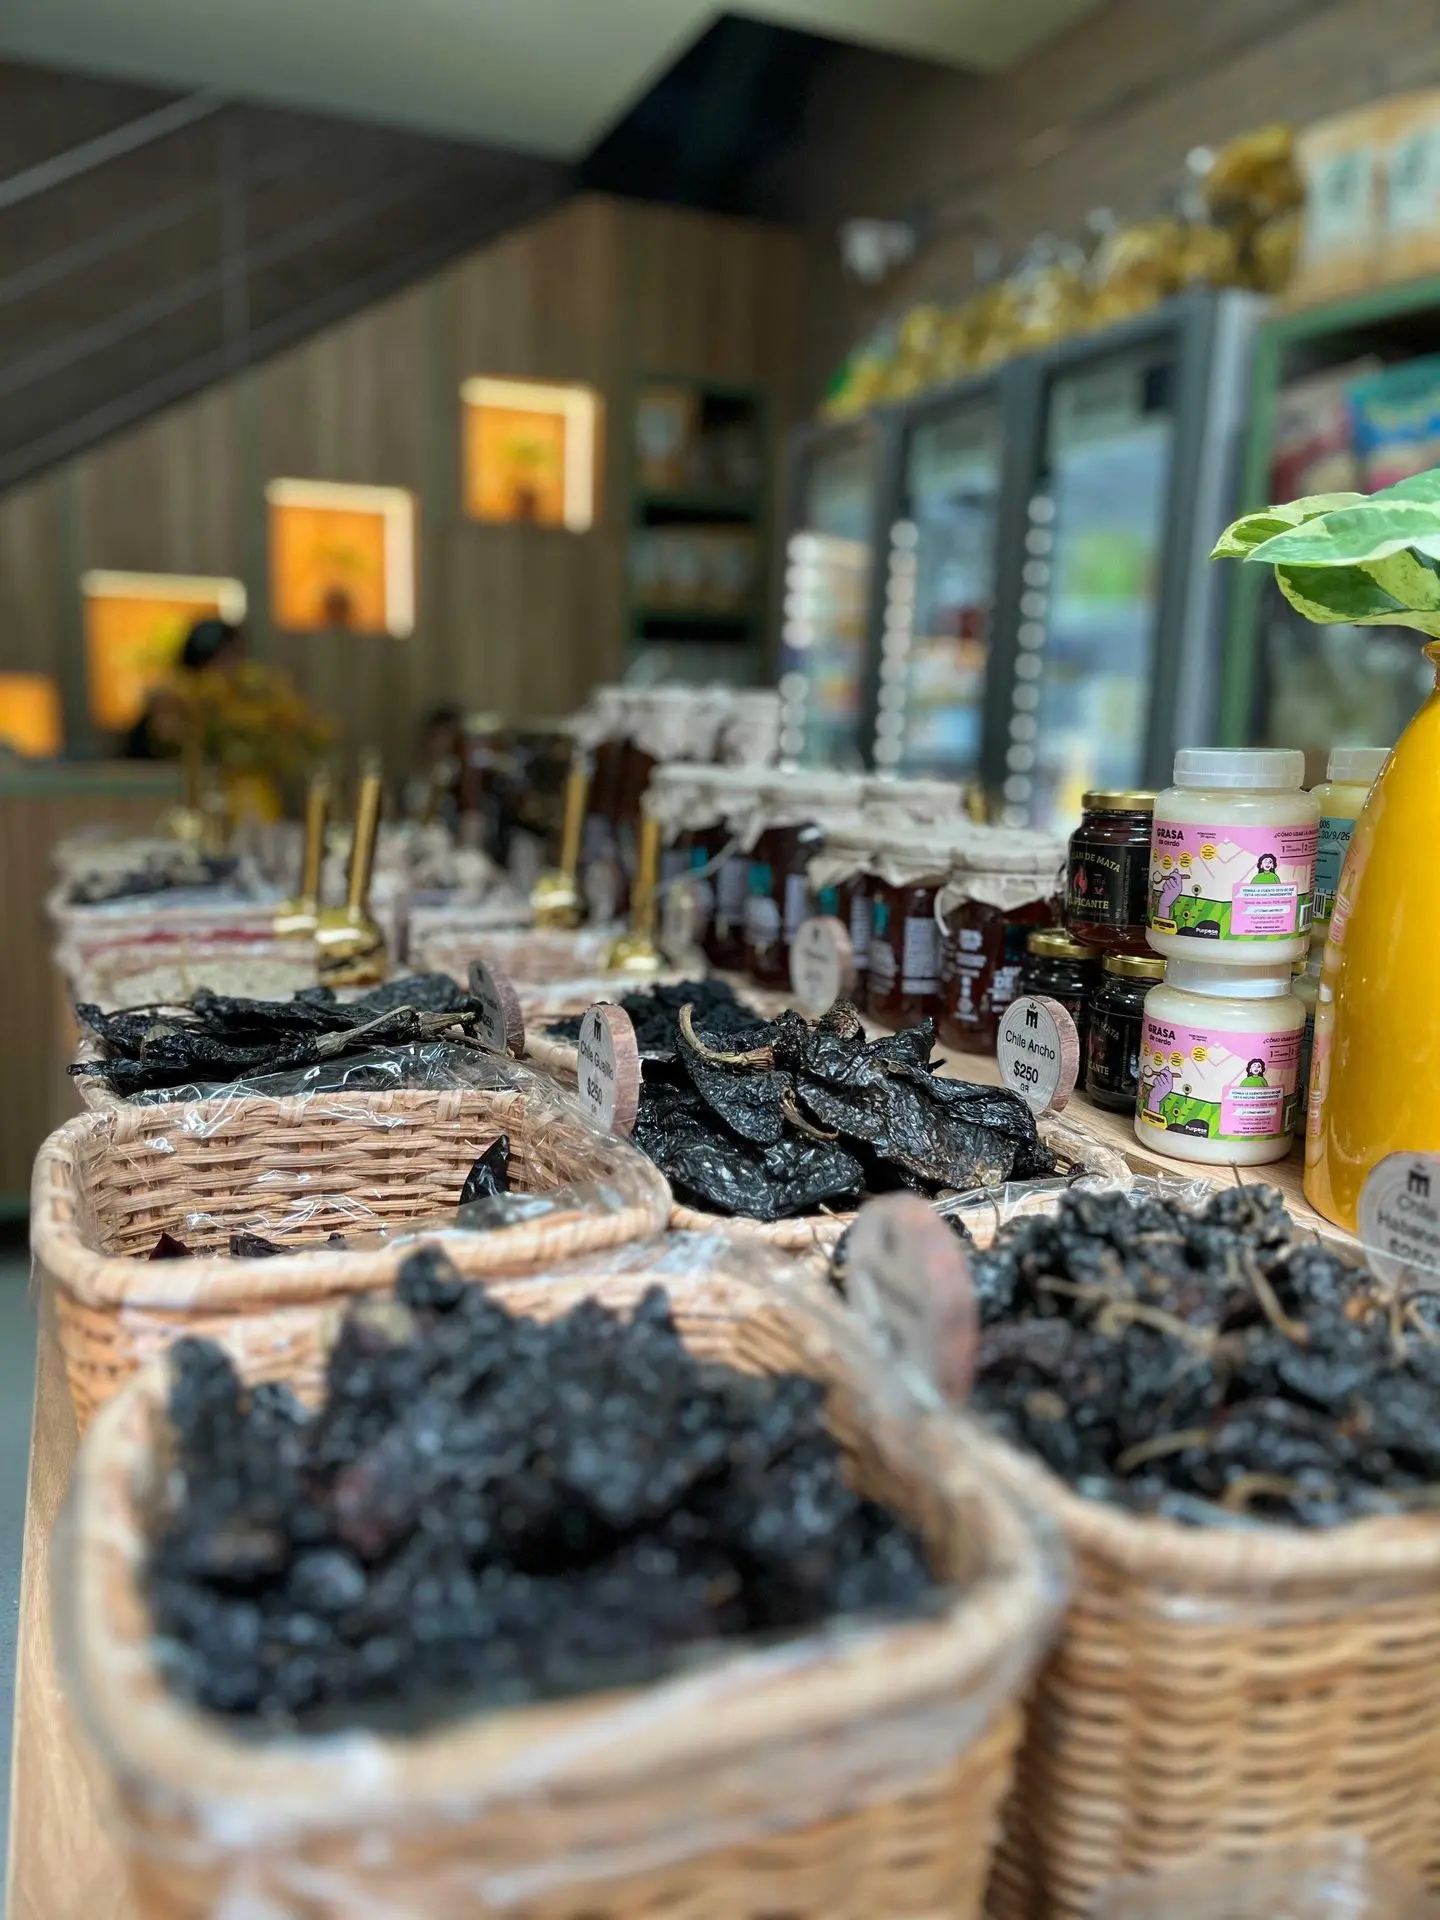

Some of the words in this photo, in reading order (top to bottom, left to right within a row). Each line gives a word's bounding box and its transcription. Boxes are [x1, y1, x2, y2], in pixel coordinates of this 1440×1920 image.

[1156, 828, 1184, 841] GRASA
[1164, 840, 1180, 848] cerdo
[1085, 852, 1096, 862] DE
[1096, 855, 1120, 873] MATA
[1195, 927, 1219, 936] Purpose
[1147, 1024, 1176, 1041] GRASA
[1005, 1030, 1026, 1049] Chile
[1027, 1040, 1056, 1060] Ancho
[1156, 1036, 1172, 1046] cerdo
[581, 1040, 594, 1062] Chile
[1013, 1060, 1039, 1084] $250
[587, 1077, 603, 1105] $250
[1020, 1083, 1030, 1094] GR
[1185, 1125, 1208, 1135] Purpose
